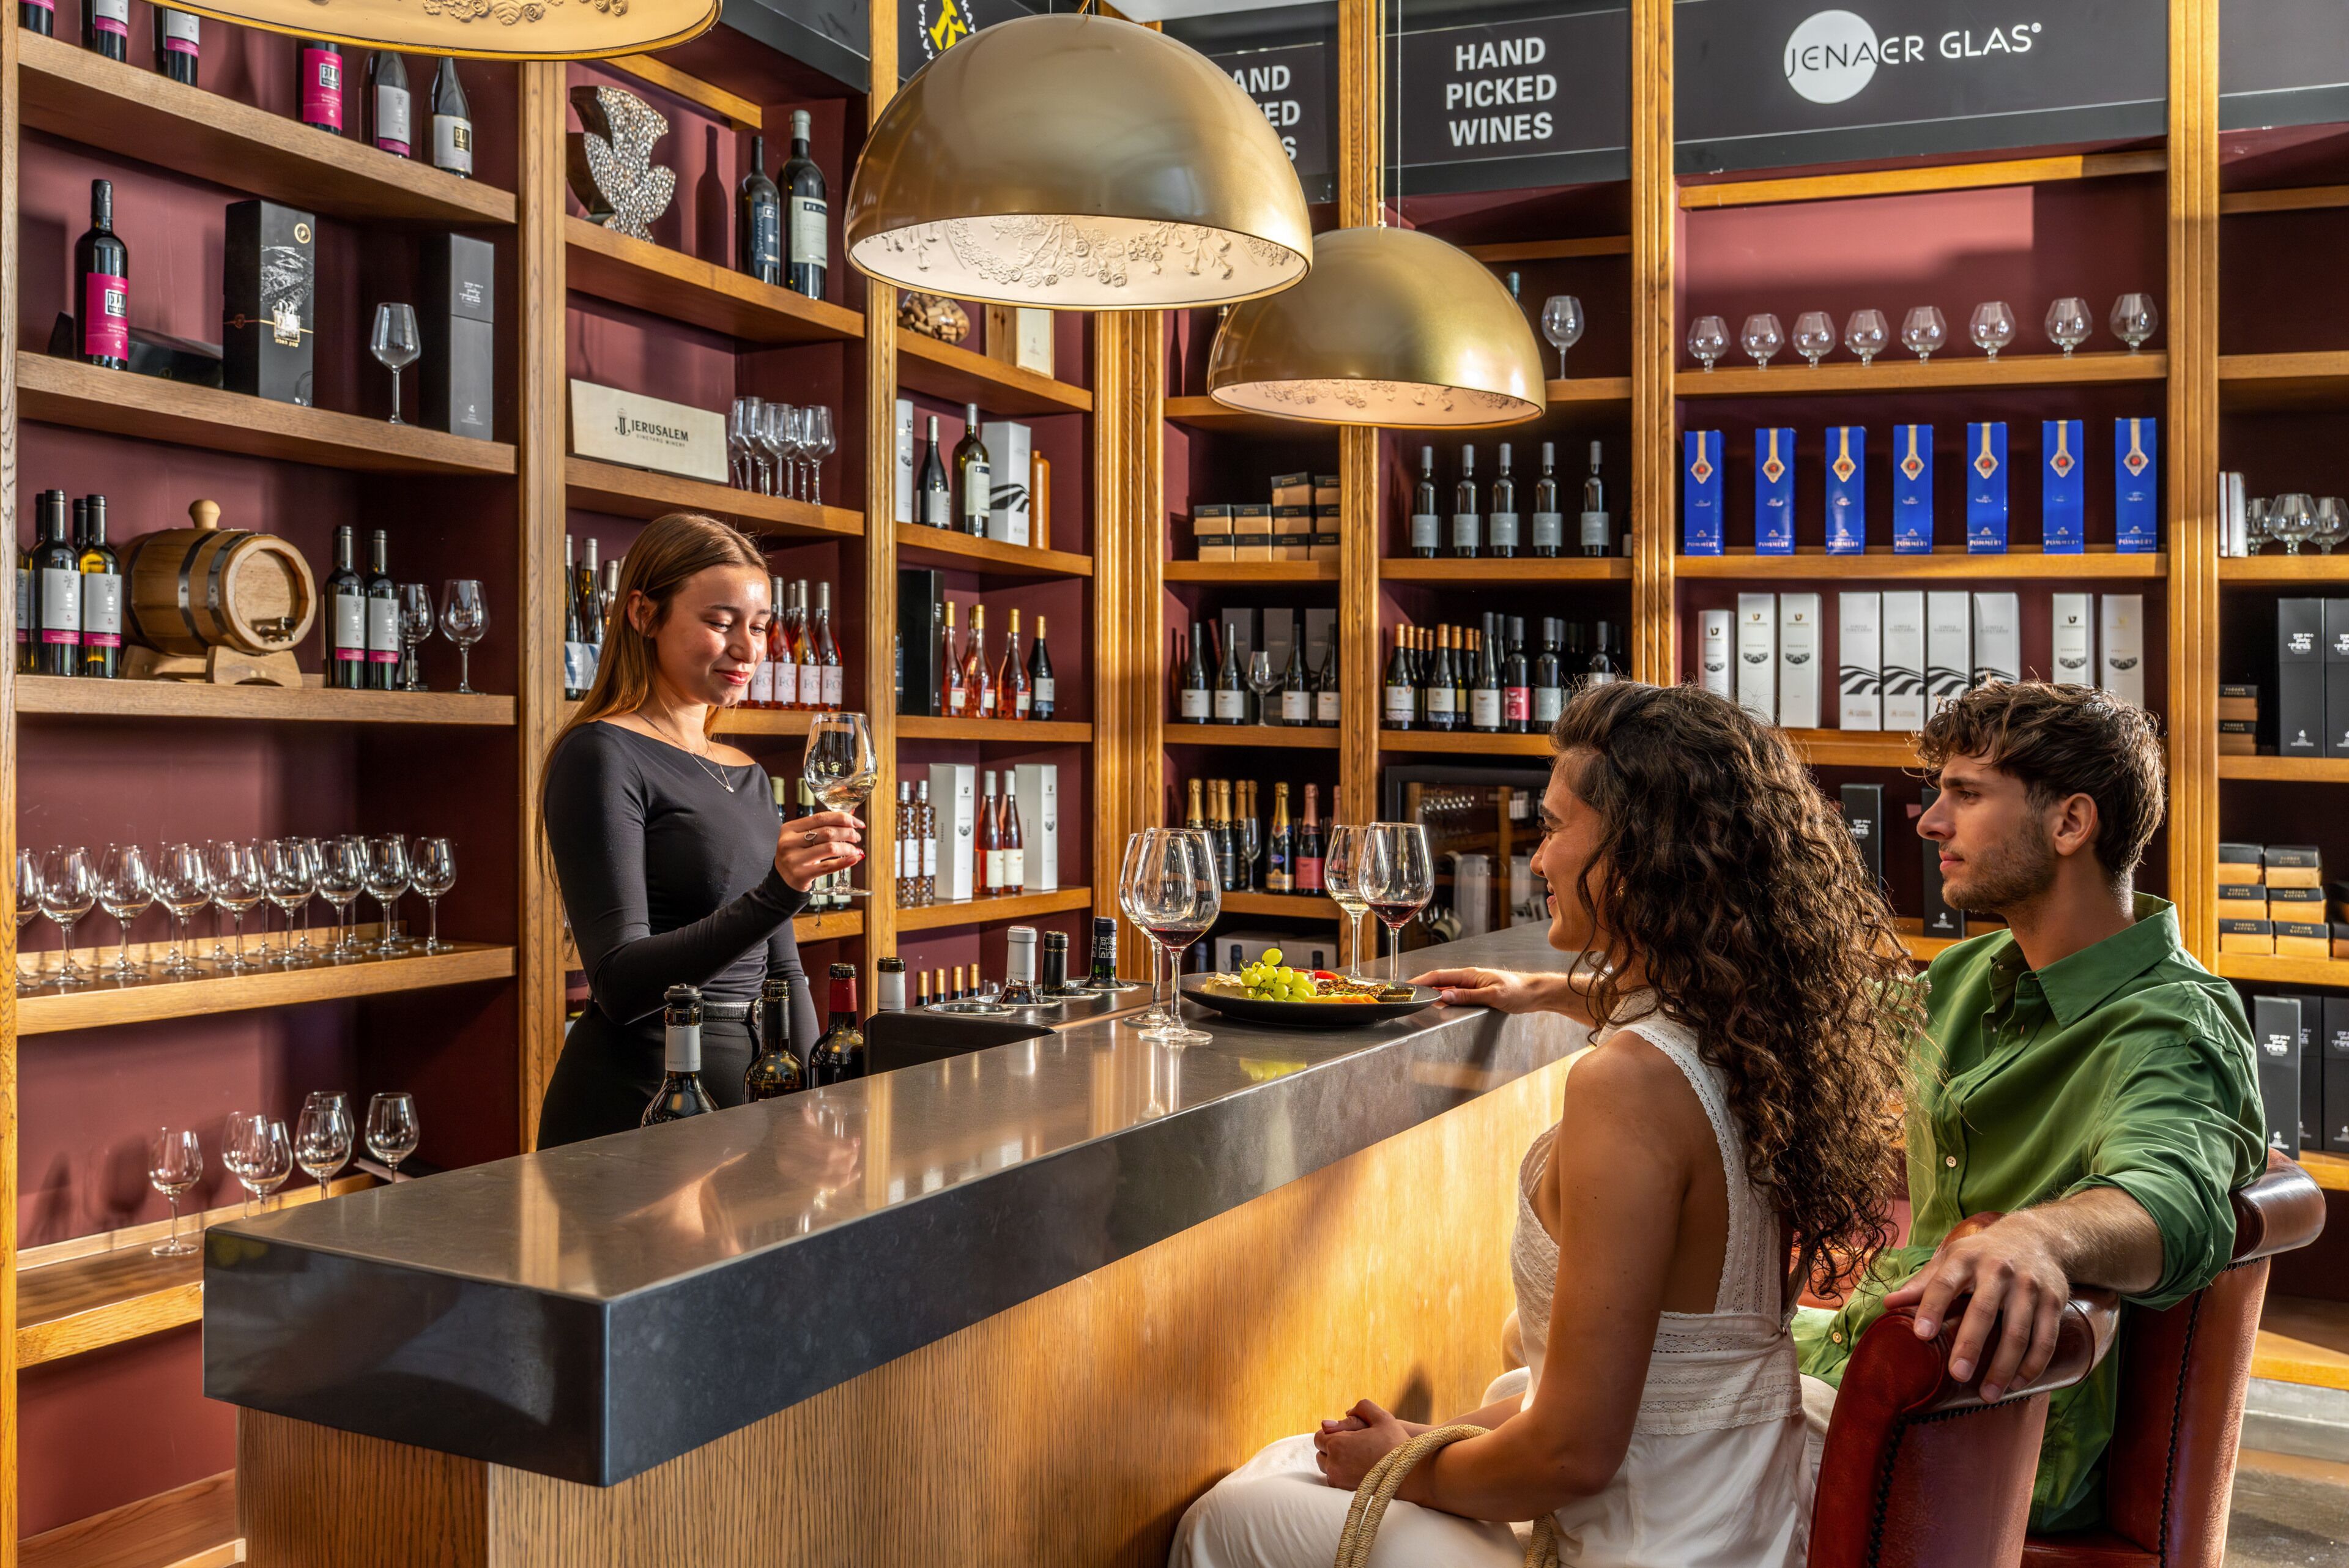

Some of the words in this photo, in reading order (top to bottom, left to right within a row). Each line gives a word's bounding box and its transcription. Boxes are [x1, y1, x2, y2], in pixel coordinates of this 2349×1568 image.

[918, 0, 935, 60] KATLA
[961, 0, 976, 34] KAT
[1456, 37, 1546, 72] HAND
[1786, 35, 1924, 79] JENAER
[1233, 65, 1291, 94] AND
[1446, 74, 1557, 110] PICKED
[1449, 112, 1553, 147] WINES
[636, 434, 663, 444] VINEYARD
[755, 675, 770, 686] RO
[779, 677, 795, 688] RO
[804, 679, 820, 689] RO
[826, 679, 842, 689] RO
